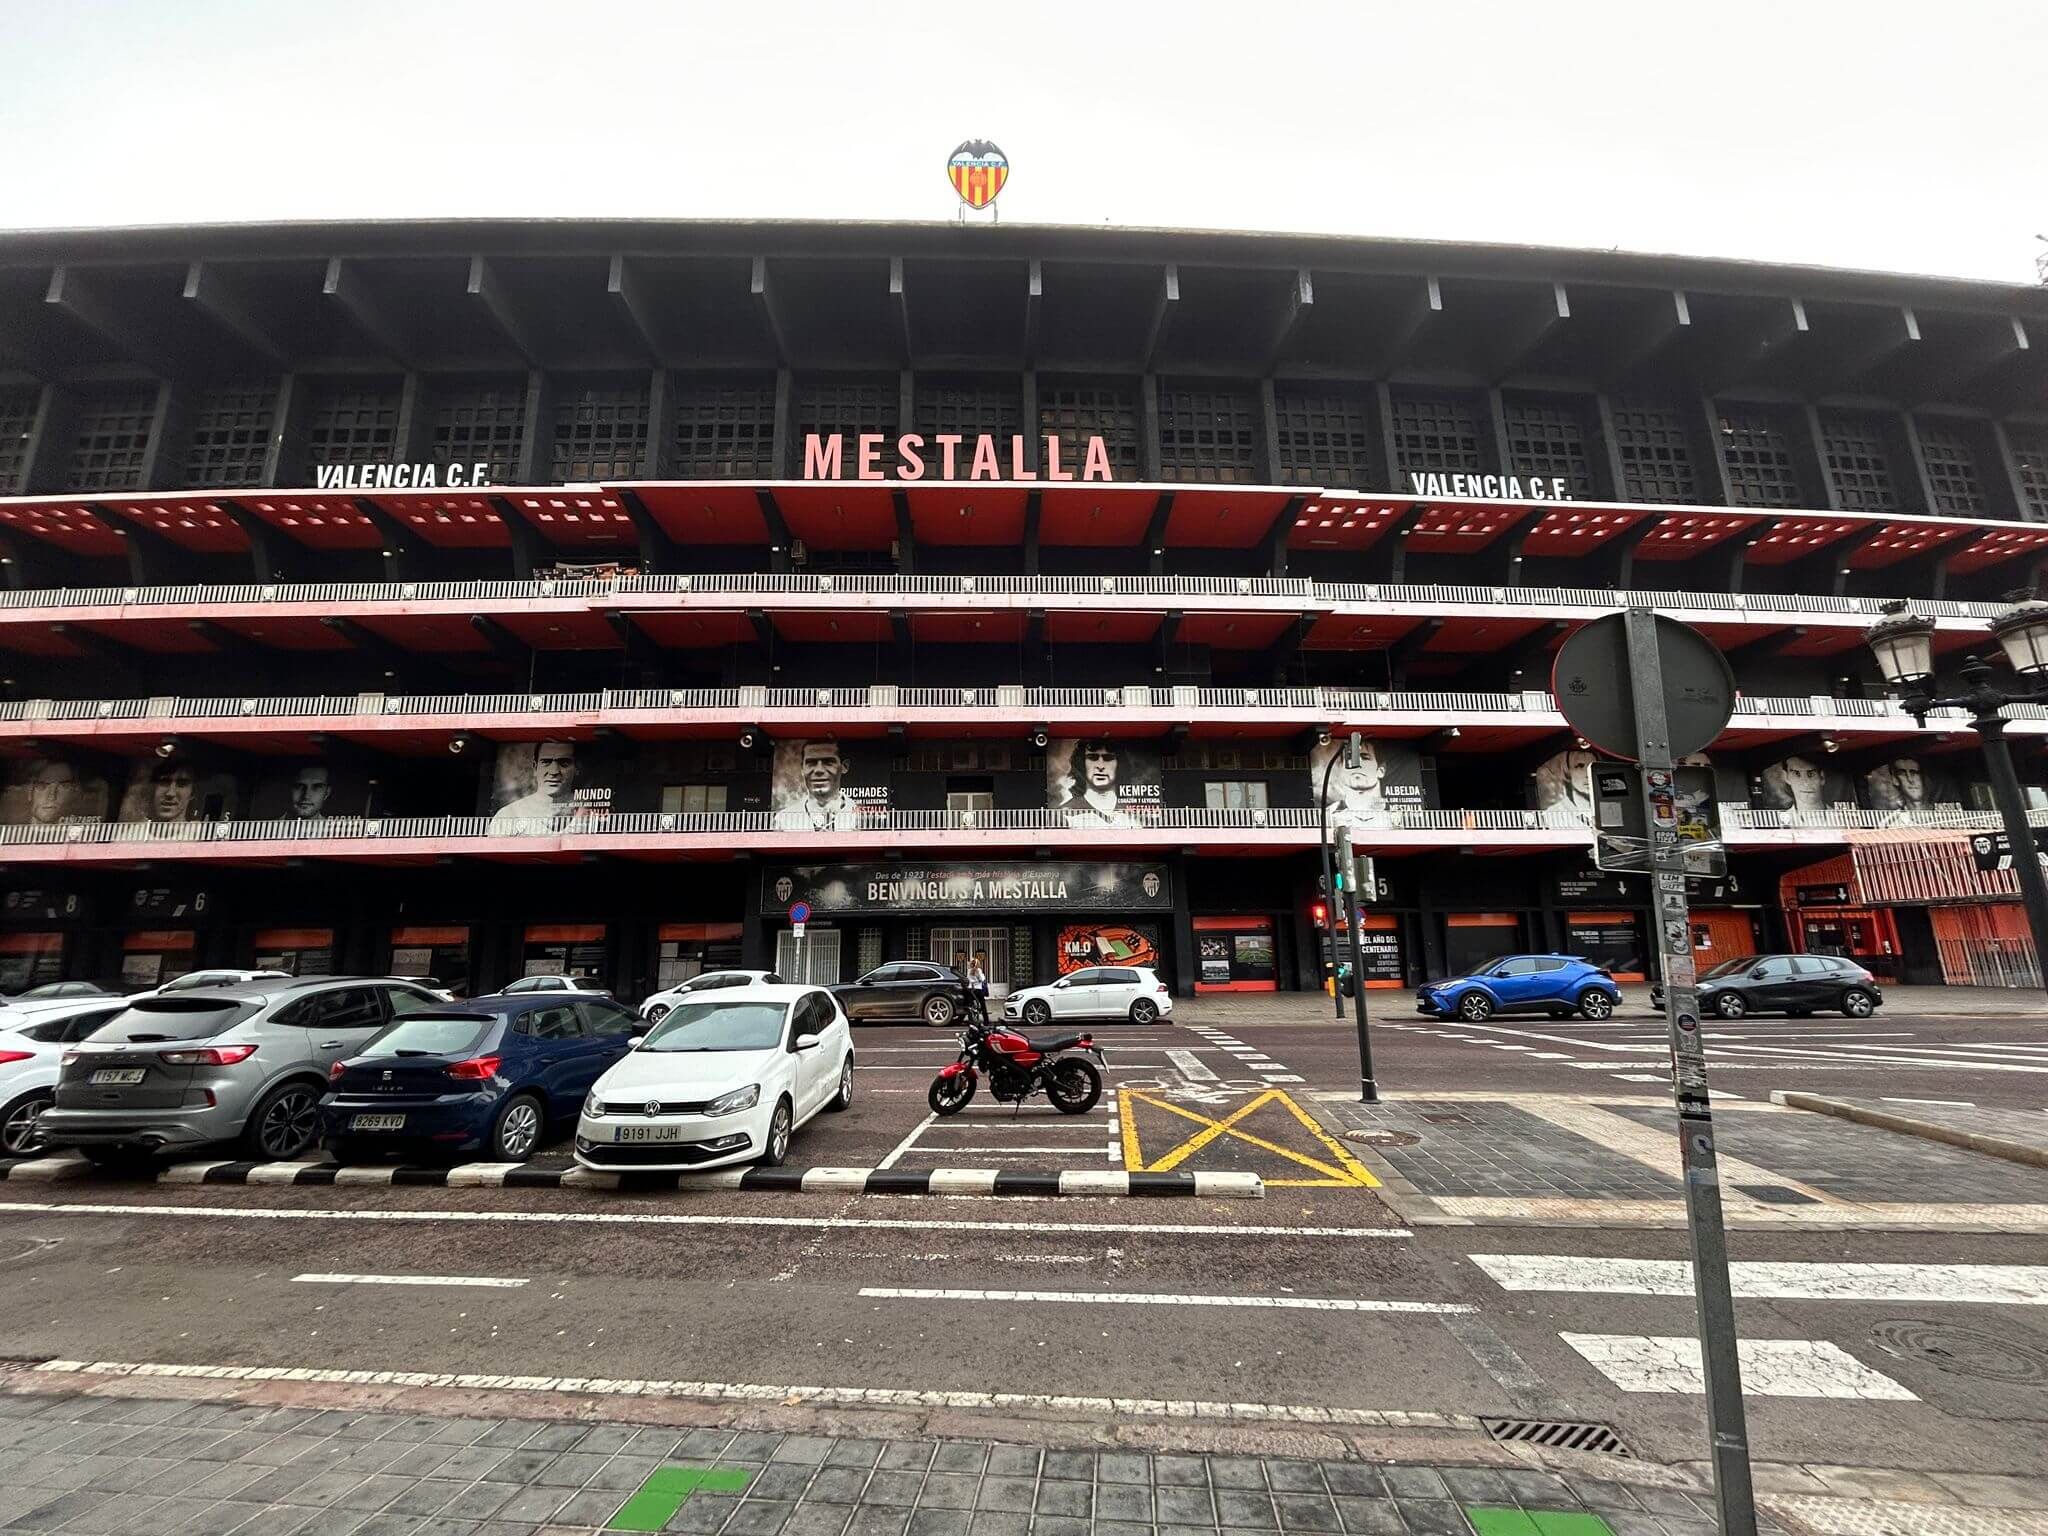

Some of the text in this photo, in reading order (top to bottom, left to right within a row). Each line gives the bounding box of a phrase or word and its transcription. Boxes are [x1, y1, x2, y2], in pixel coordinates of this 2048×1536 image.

[803, 433, 1114, 481] MESTALLA
[316, 462, 491, 489] VALENCIA C.F.
[1410, 472, 1573, 501] VALENCIA C.F.
[573, 788, 612, 801] MUNDO
[1119, 784, 1161, 797] KEMPES
[1385, 785, 1421, 796] ALBELDA
[903, 870, 924, 879] 1923
[1728, 874, 1739, 893] 3
[973, 880, 984, 899] A
[988, 880, 1068, 899] MESTALLA
[1378, 878, 1388, 896] 5
[66, 894, 77, 913] 8
[194, 892, 206, 911] 6
[622, 1127, 678, 1140] 9191 JJH
